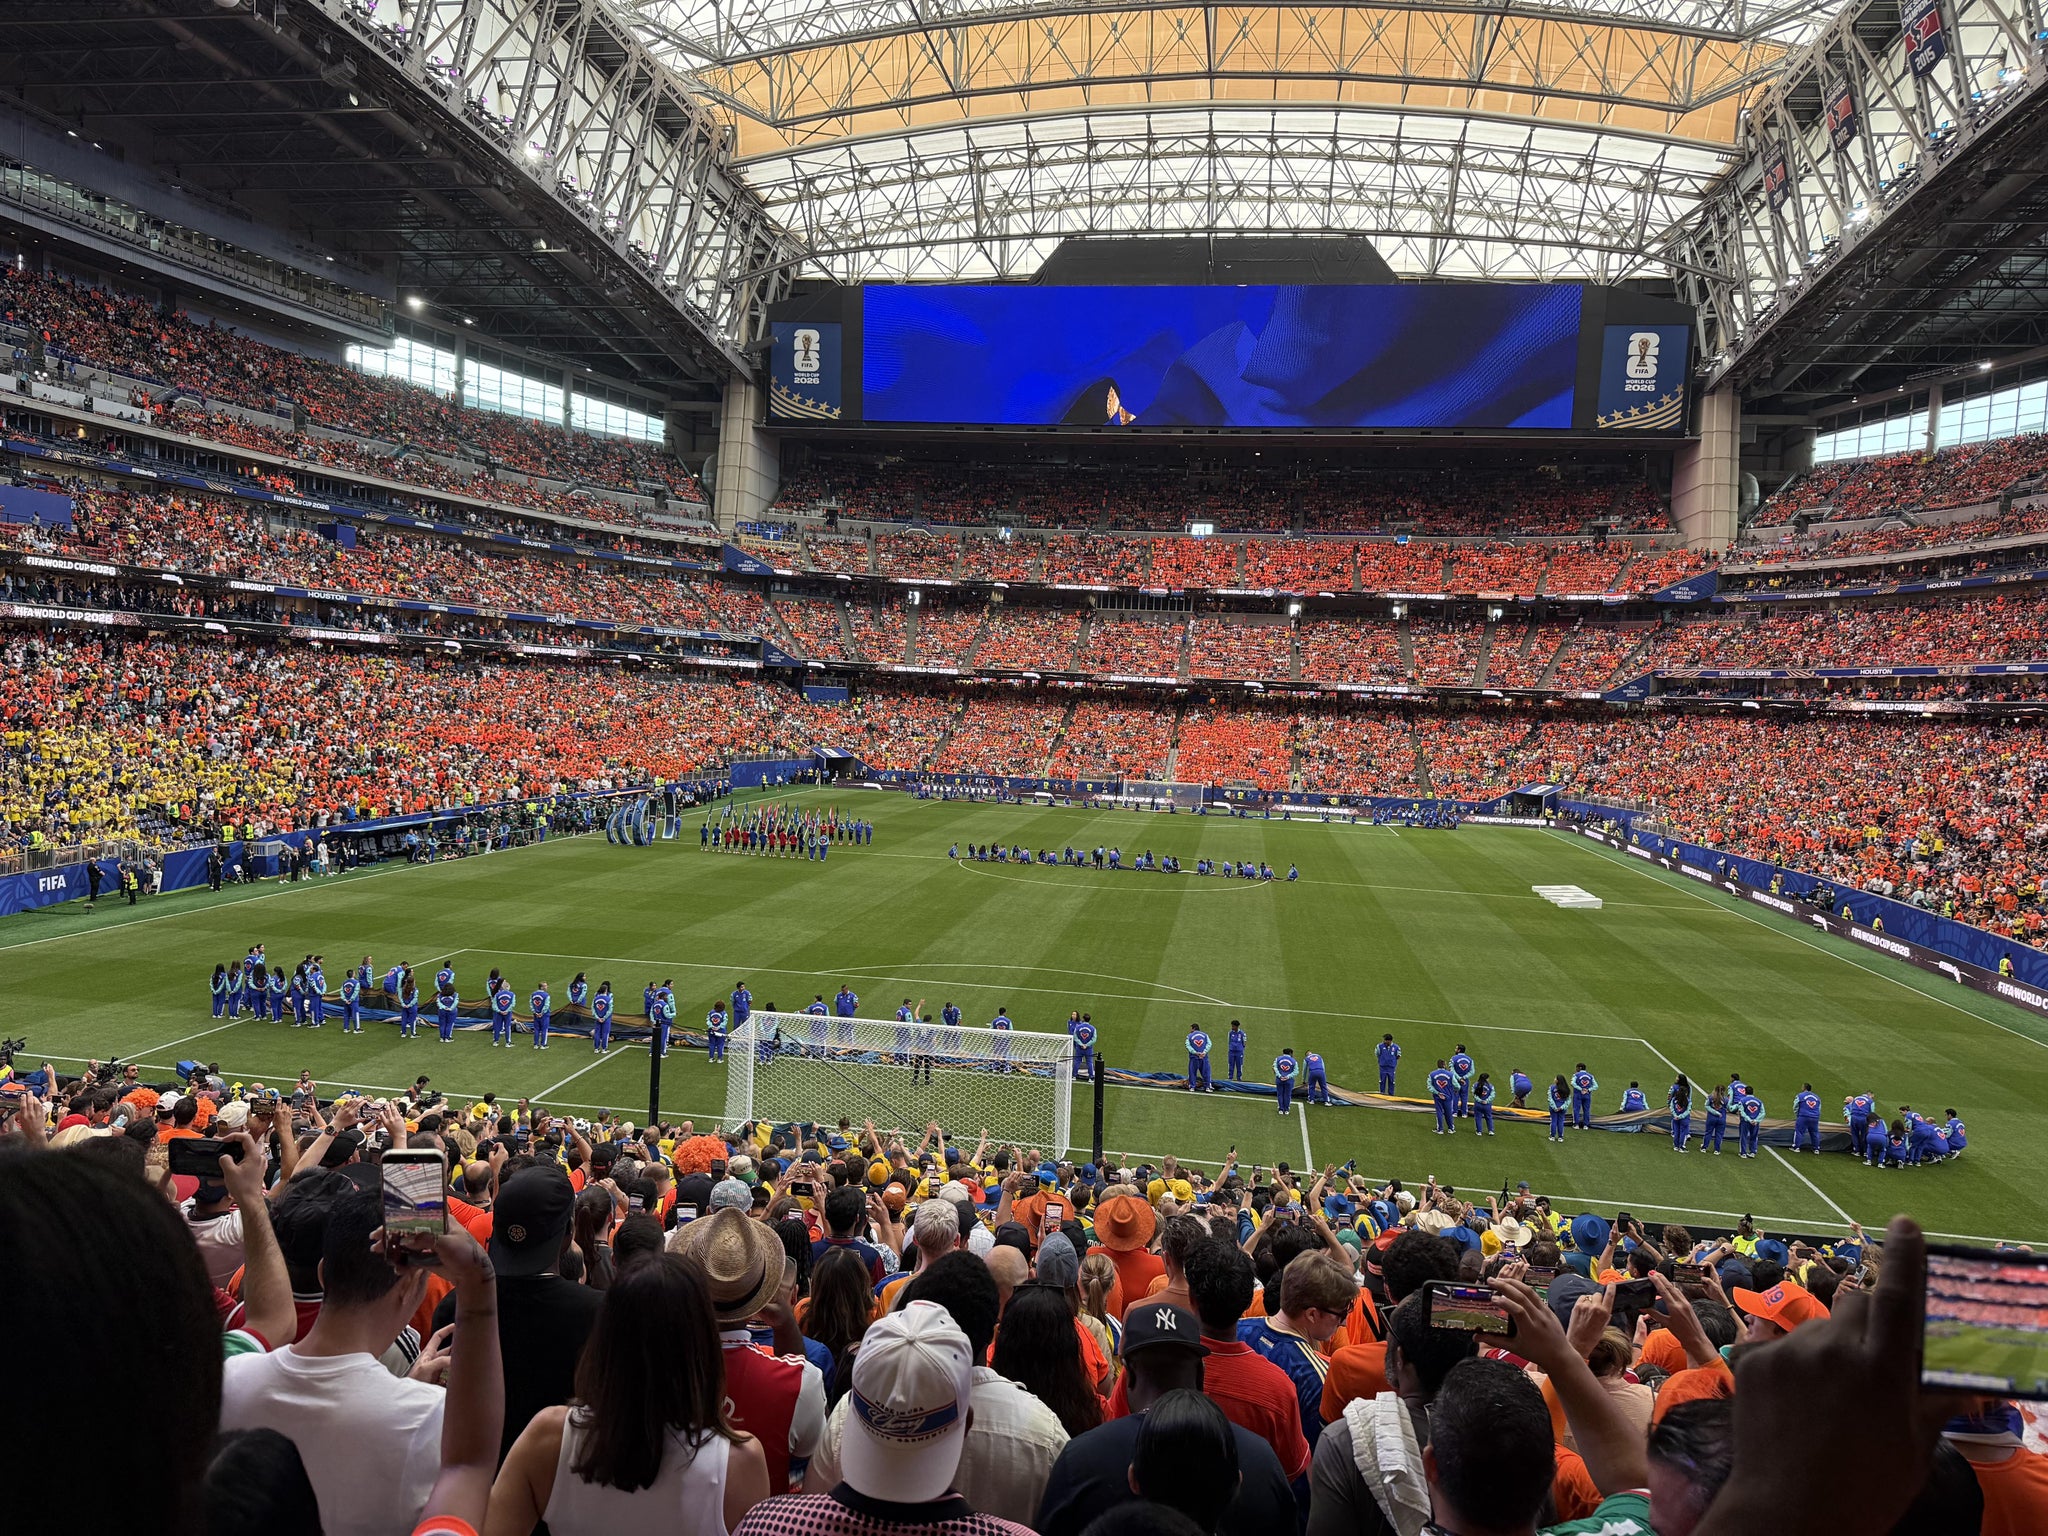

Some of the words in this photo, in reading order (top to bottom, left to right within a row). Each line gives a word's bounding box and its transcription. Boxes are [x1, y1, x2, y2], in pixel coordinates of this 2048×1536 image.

[1914, 46, 1936, 72] 2015
[1835, 126, 1850, 148] 2012
[285, 497, 302, 505] WORLD
[521, 540, 550, 549] HOUSTON
[26, 556, 44, 566] FIFA
[45, 559, 73, 570] WORLD
[74, 562, 90, 572] CUP
[90, 564, 116, 576] 2026
[244, 582, 265, 591] WORLD
[308, 592, 348, 601] HOUSTON
[14, 605, 34, 617] FIFA
[34, 608, 66, 619] WORLD
[66, 611, 83, 620] CUP
[84, 612, 113, 624] 2026
[1905, 704, 1923, 712] 2026
[39, 874, 67, 892] FIFA
[1760, 893, 1772, 905] WORLD
[1780, 900, 1793, 913] 2026
[1851, 927, 1862, 938] FIFA
[1862, 931, 1880, 946] WORLD
[1880, 938, 1890, 949] CUP
[1890, 942, 1910, 957] 2026
[1998, 981, 2014, 997] FIFA
[2014, 987, 2042, 1007] WORLD
[1155, 1308, 1176, 1330] NY
[875, 1400, 895, 1414] MADE
[908, 1406, 924, 1415] USA
[897, 1428, 948, 1442] GARMENTS
